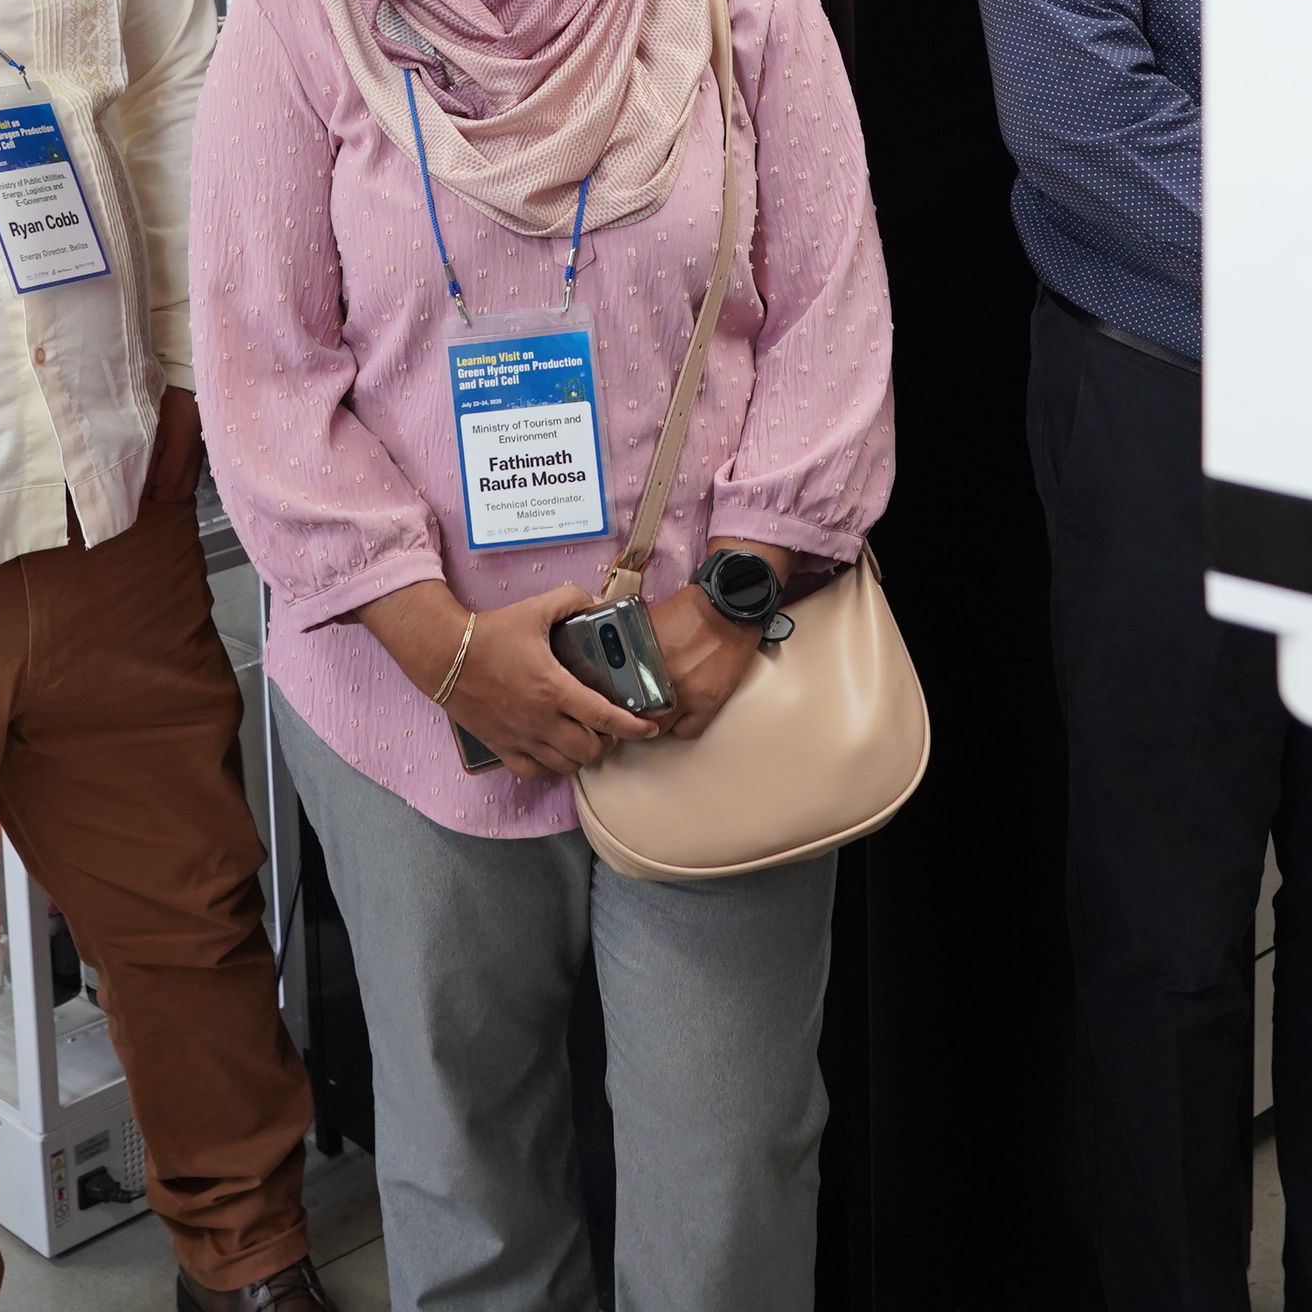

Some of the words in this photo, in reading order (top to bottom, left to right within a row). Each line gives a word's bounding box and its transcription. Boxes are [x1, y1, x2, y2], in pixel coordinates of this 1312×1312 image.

[11, 120, 21, 128] on
[20, 124, 55, 137] Production
[1, 140, 16, 150] Cell
[24, 176, 42, 186] Public
[2, 190, 26, 200] Energy,
[25, 184, 53, 196] Logistics
[53, 182, 64, 190] and
[15, 194, 58, 208] E-Governance
[8, 220, 45, 239] Ryan
[45, 211, 80, 230] Cobb
[19, 251, 42, 262] Energy
[42, 246, 69, 258] Director,
[69, 242, 89, 252] Belize
[456, 354, 497, 367] Learning
[498, 351, 521, 362] Visit
[522, 351, 534, 360] on
[457, 368, 485, 379] Green
[487, 362, 530, 376] Hydrogen
[532, 356, 583, 371] Production
[459, 379, 476, 391] and
[478, 376, 499, 388] Fuel
[500, 374, 520, 385] Cell
[461, 400, 472, 408] July
[472, 423, 510, 434] Ministry
[512, 420, 522, 430] of
[523, 417, 562, 429] Tourism
[564, 414, 582, 424] and
[498, 430, 558, 444] Environment
[489, 449, 573, 472] Fathimath
[479, 474, 528, 493] Raufa
[532, 470, 587, 487] Moosa
[485, 499, 528, 512] Technical
[530, 495, 585, 507] Coordinator,
[516, 508, 556, 520] Maldives
